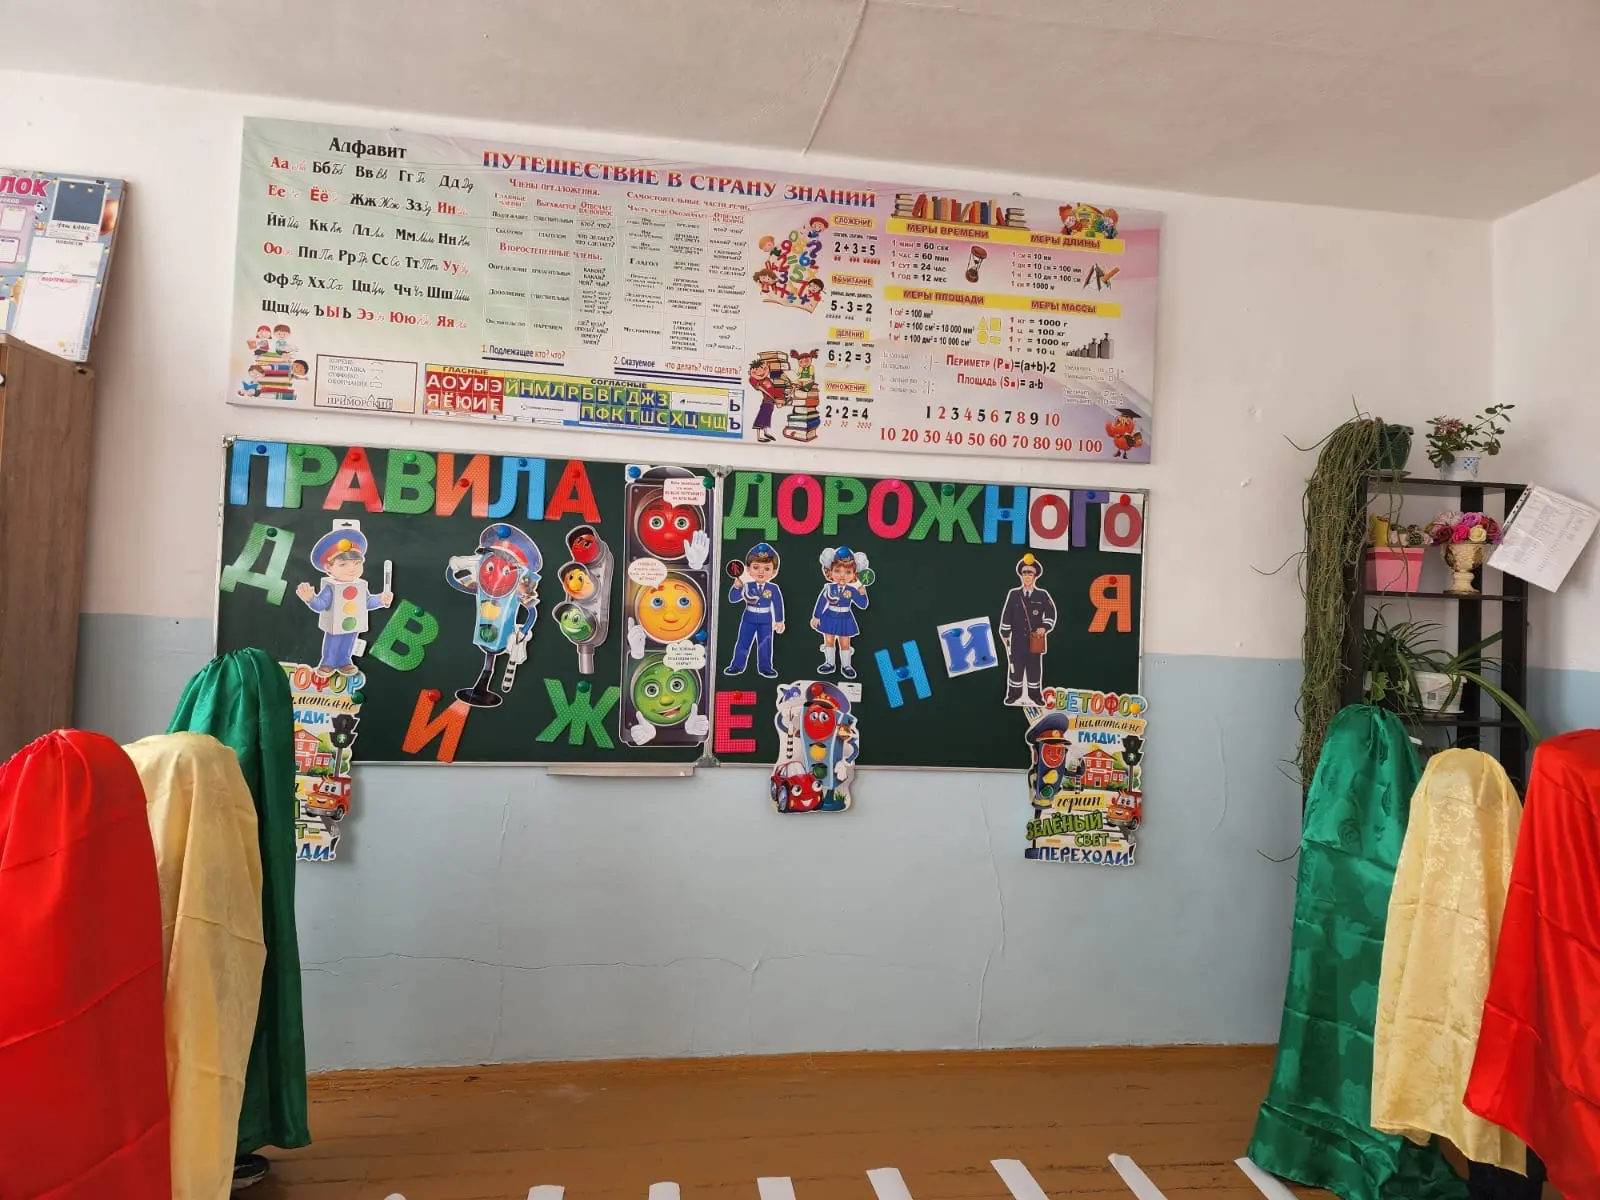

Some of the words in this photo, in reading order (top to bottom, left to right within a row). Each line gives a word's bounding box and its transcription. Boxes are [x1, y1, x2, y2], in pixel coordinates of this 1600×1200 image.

[329, 137, 407, 159] Алфавит
[483, 151, 659, 186] ПУТЕШЕСТВИЕ
[668, 172, 682, 188] В
[690, 175, 776, 198] СТРАНУ
[784, 184, 876, 208] ЗНАНИЙ
[907, 223, 937, 234] МЕРЫ
[940, 227, 989, 238] ВРЕМЕНИ
[1031, 234, 1060, 245] МЕРЫ
[1063, 238, 1100, 248] ДЛИНЫ
[920, 263, 931, 271] 24
[921, 274, 931, 282] 12
[903, 291, 933, 300] МЕРЫ
[1031, 300, 1059, 311] МЕРЫ
[1062, 303, 1096, 313] МАССЫ
[489, 345, 533, 357] Подлежащее
[534, 350, 549, 358] кто?
[551, 351, 565, 359] что?
[443, 366, 488, 375] ГЛАСНЫЕ
[621, 357, 655, 368] Сказуемое
[677, 363, 701, 372] делать?
[714, 366, 741, 375] сделать?
[591, 378, 647, 389] СОГЛАСНЫЕ
[926, 406, 931, 419] 1
[937, 406, 946, 419] 2
[951, 407, 959, 421] 3
[964, 408, 972, 421] 4
[977, 409, 986, 422] 5
[990, 410, 999, 423] 6
[1004, 410, 1012, 424] 7
[1016, 411, 1026, 424] 8
[1030, 412, 1039, 425] 9
[1045, 413, 1060, 426] 10
[880, 428, 896, 441] 10
[901, 429, 918, 442] 20
[923, 430, 940, 444] 30
[946, 431, 963, 445] 40
[968, 432, 985, 446] 50
[990, 434, 1007, 448] 60
[1012, 435, 1029, 449] 70
[1033, 436, 1050, 450] 80
[1055, 438, 1072, 451] 90
[1078, 439, 1102, 452] 100
[230, 439, 601, 523] ПРАВИЛА
[723, 472, 1143, 548] ДОРОЖНОГО
[1043, 688, 1147, 716] СВЕТОФОР
[1056, 797, 1101, 813] горит
[1026, 809, 1103, 841] ЗЕЛЁНЫЙ
[1038, 844, 1137, 866] ПЕРЕХОДИ!
